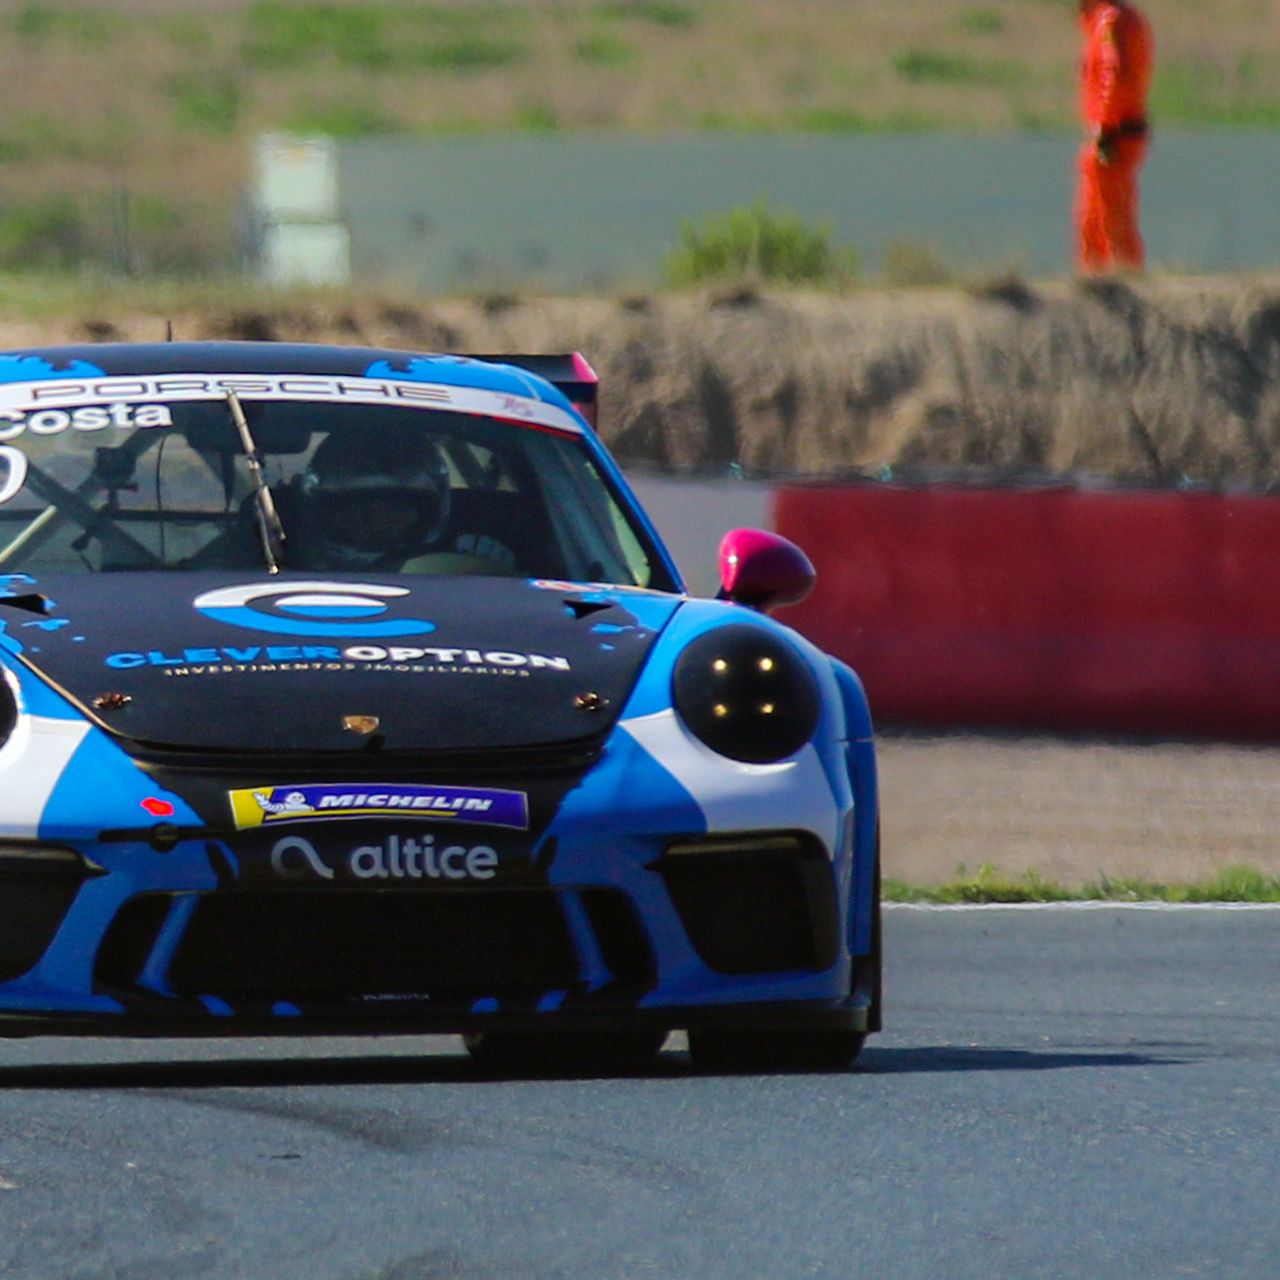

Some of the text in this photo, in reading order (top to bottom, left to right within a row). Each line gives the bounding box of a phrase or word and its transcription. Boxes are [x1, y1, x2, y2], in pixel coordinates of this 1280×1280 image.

[31, 380, 451, 401] PORSCHE
[163, 662, 356, 677] INVESTIMENTOS
[318, 793, 493, 812] MICHELIN
[350, 833, 499, 880] altice
